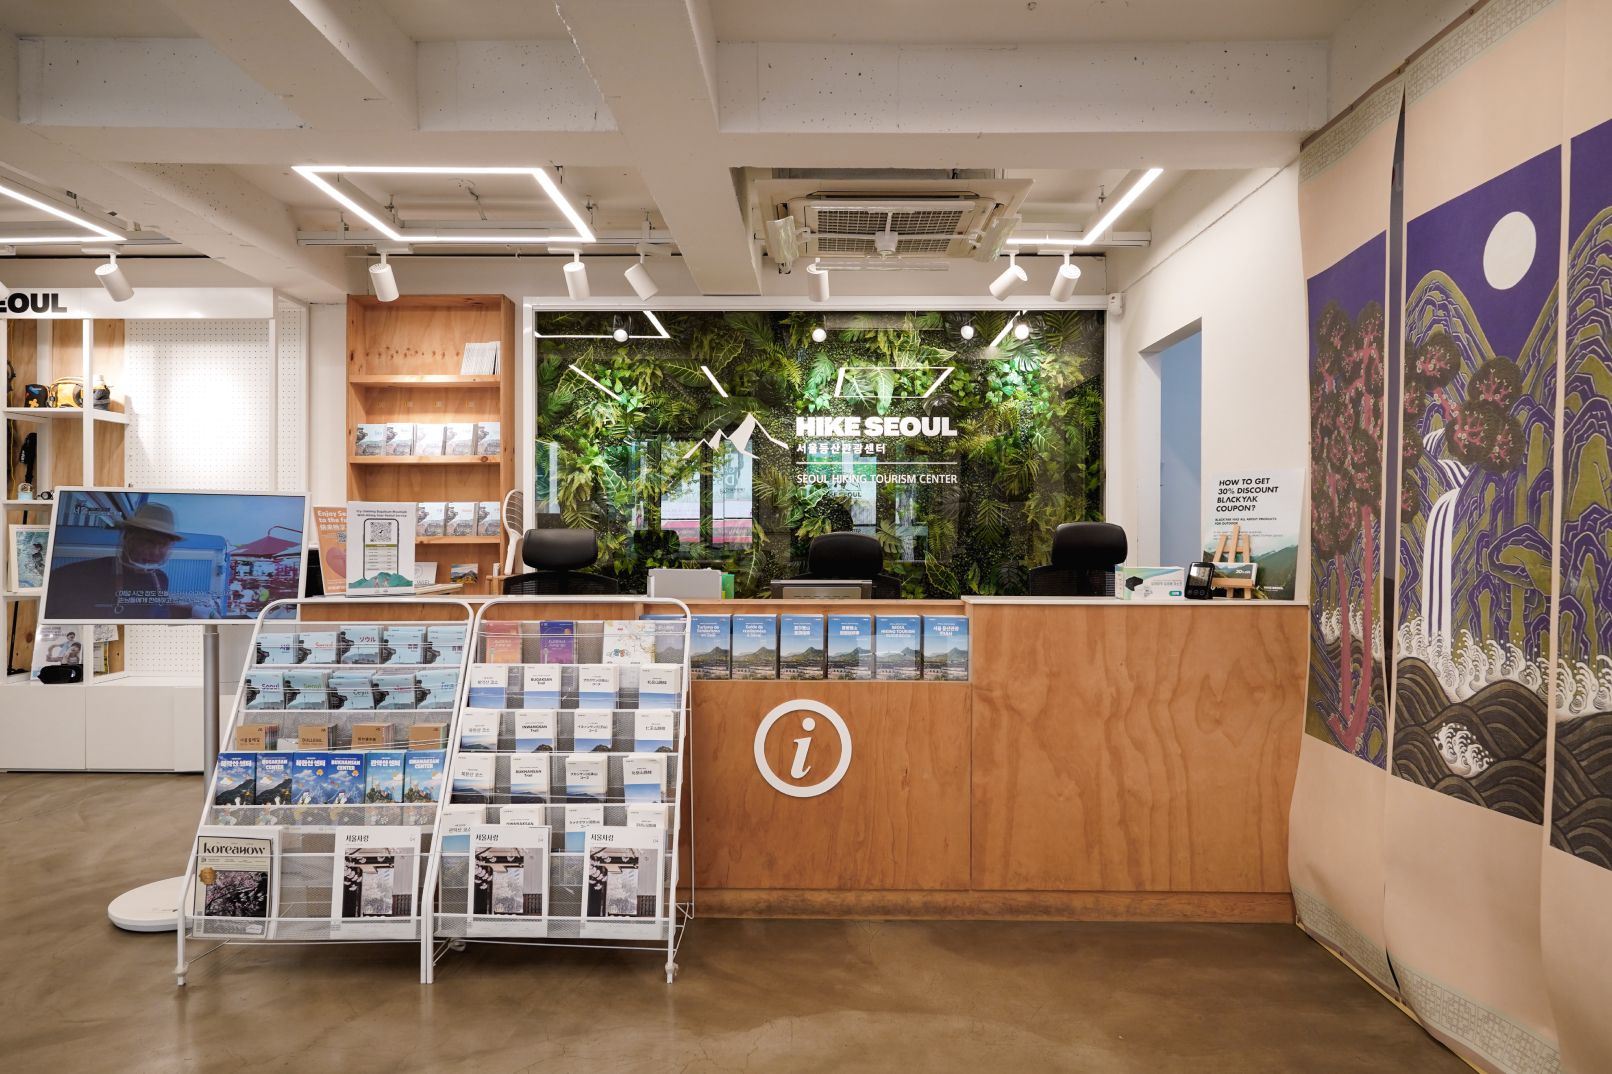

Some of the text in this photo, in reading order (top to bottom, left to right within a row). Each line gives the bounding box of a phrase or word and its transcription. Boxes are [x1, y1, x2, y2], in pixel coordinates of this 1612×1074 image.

[0, 293, 67, 313] OUL
[796, 416, 958, 437] HIKE SEOUL
[796, 443, 886, 455] 서울등산관광센터
[797, 474, 958, 484] SEOUL HIKING TOURISM CENTER
[1255, 477, 1271, 485] GET
[1218, 486, 1279, 495] 30% DISCOUNT
[1216, 504, 1256, 512] COUPON?
[317, 510, 337, 518] Enjoy
